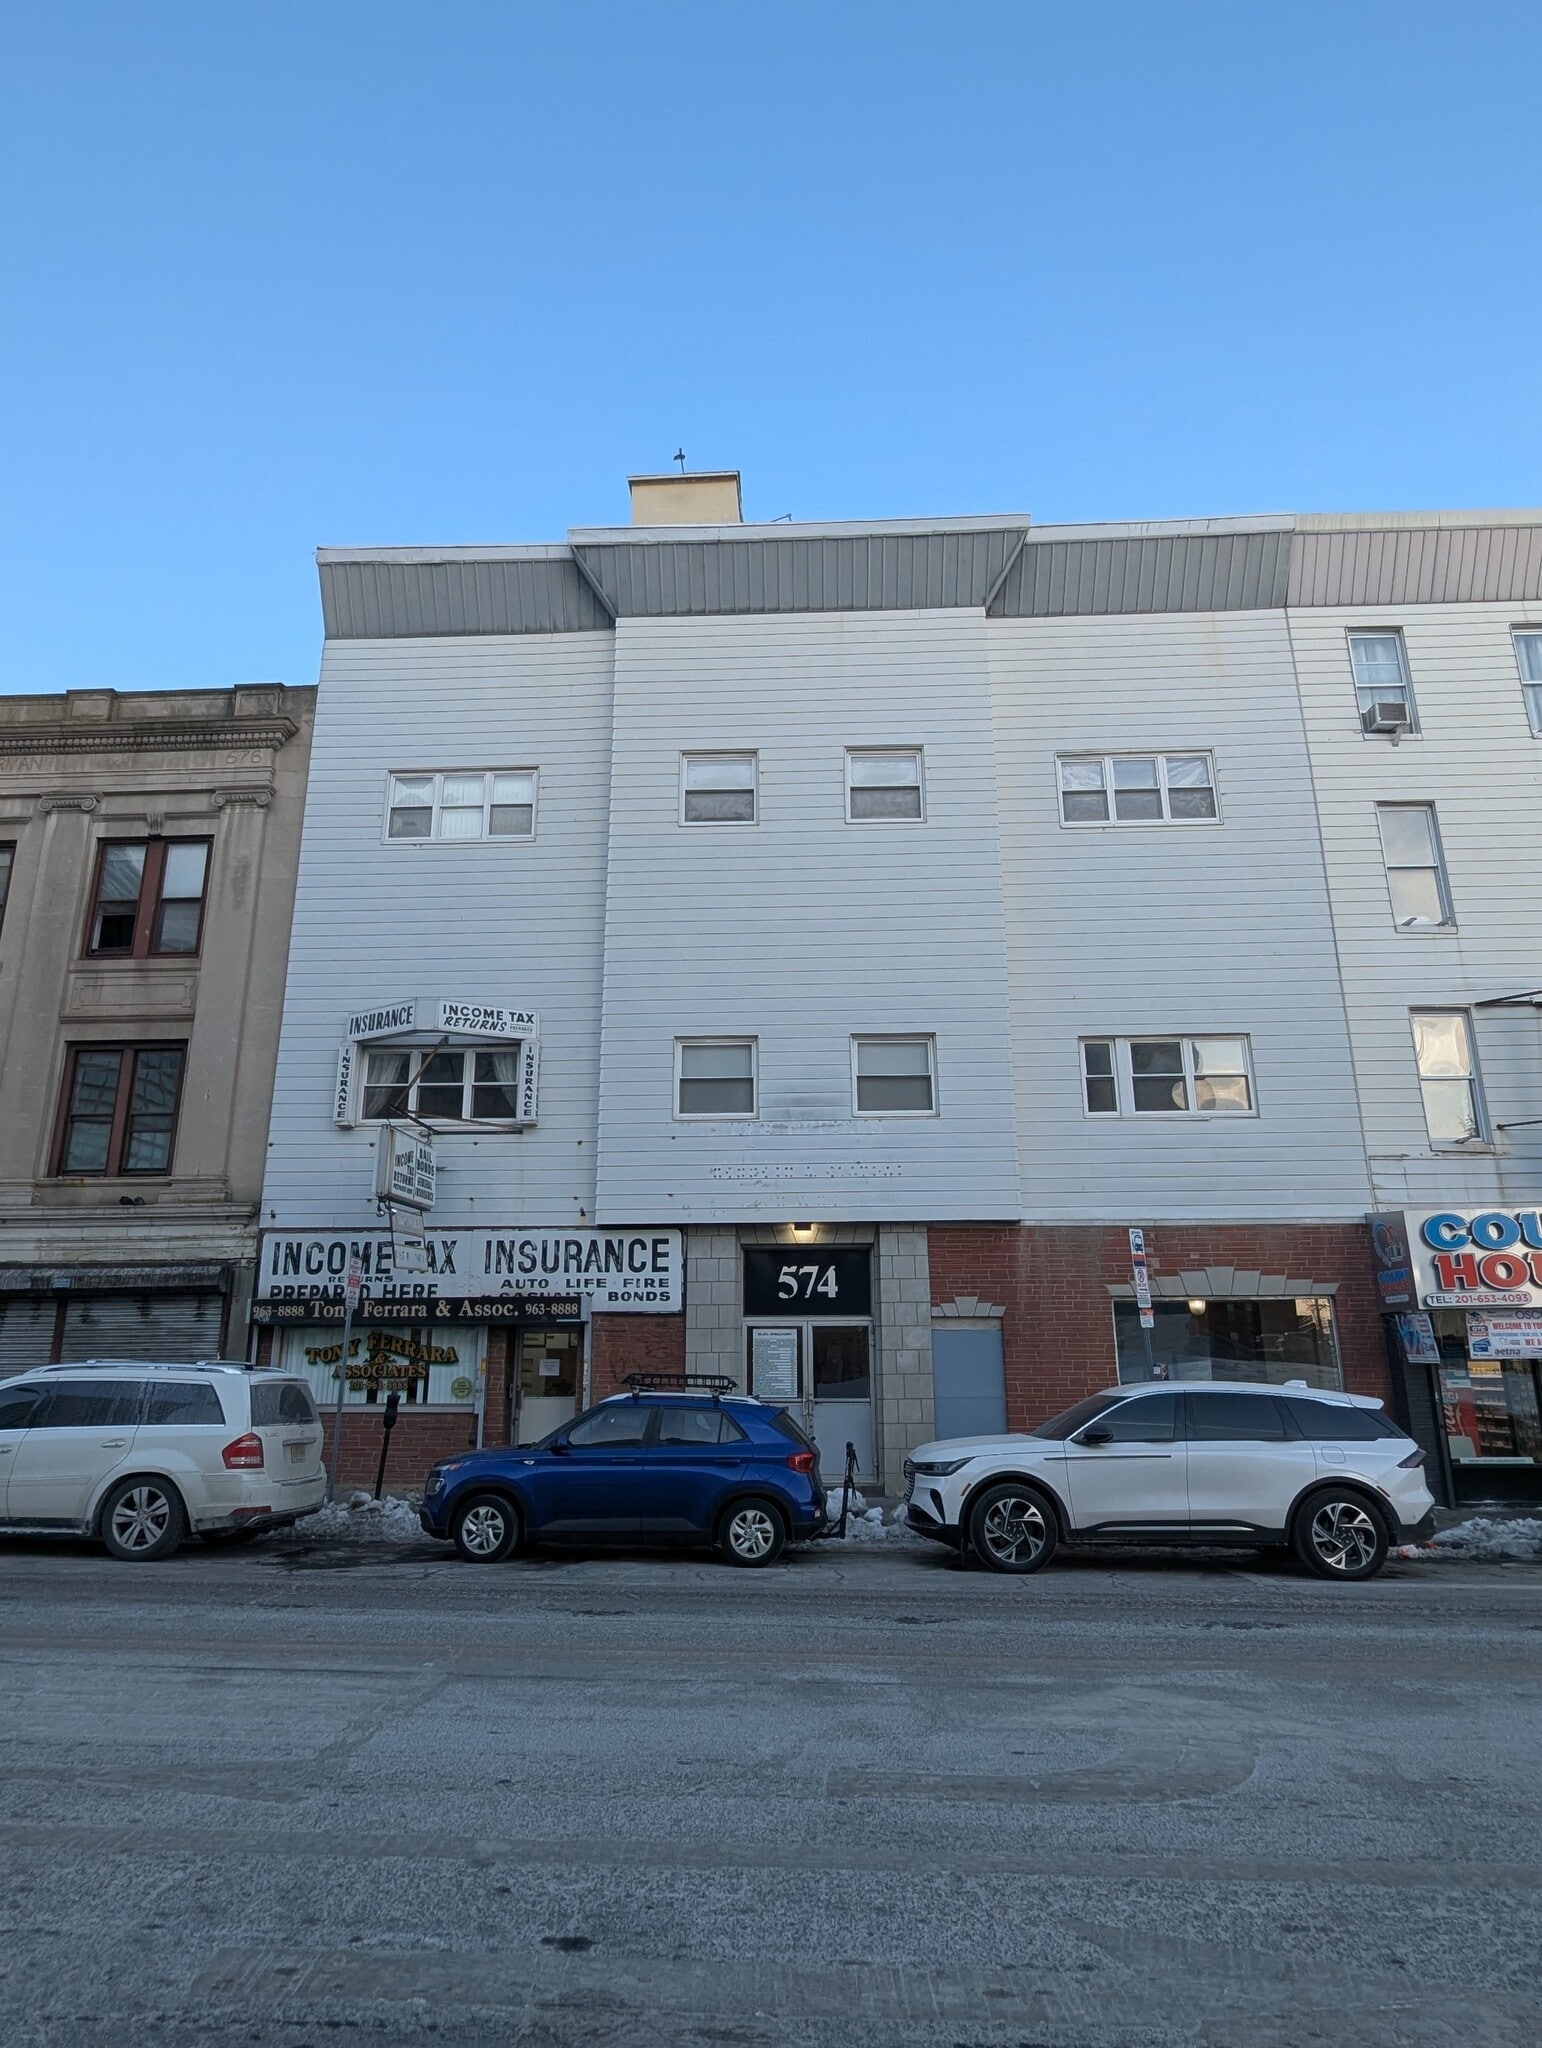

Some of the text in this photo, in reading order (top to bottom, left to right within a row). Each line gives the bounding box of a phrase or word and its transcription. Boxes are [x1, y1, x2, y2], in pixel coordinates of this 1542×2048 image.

[349, 1005, 413, 1035] INSURANCE
[443, 1004, 535, 1024] INCOME TAX
[444, 1016, 507, 1032] RETURNS
[337, 1048, 350, 1118] INSURANCE
[523, 1046, 534, 1116] INSURANCE
[271, 1241, 392, 1276] INCOME
[484, 1238, 670, 1274] INSURANCE
[328, 1275, 394, 1283] RERNS
[501, 1278, 670, 1289] AUTO LIFE FIRE
[778, 1265, 838, 1299] 574
[269, 1284, 370, 1299] PREPARD
[383, 1284, 438, 1298] HERE
[607, 1291, 671, 1302] BONDS
[1429, 1293, 1529, 1304] TEL: 201-653-4093
[253, 1300, 578, 1318] 963-8888 Ton Ferrara & Assoc. 963-8888
[1515, 1310, 1542, 1319] OSC
[1492, 1322, 1522, 1330] WELCOME
[305, 1334, 459, 1365] TONY FERRARA
[1494, 1348, 1520, 1356] aetna
[373, 1351, 388, 1364] &
[332, 1364, 427, 1378] ASSOCIATES
